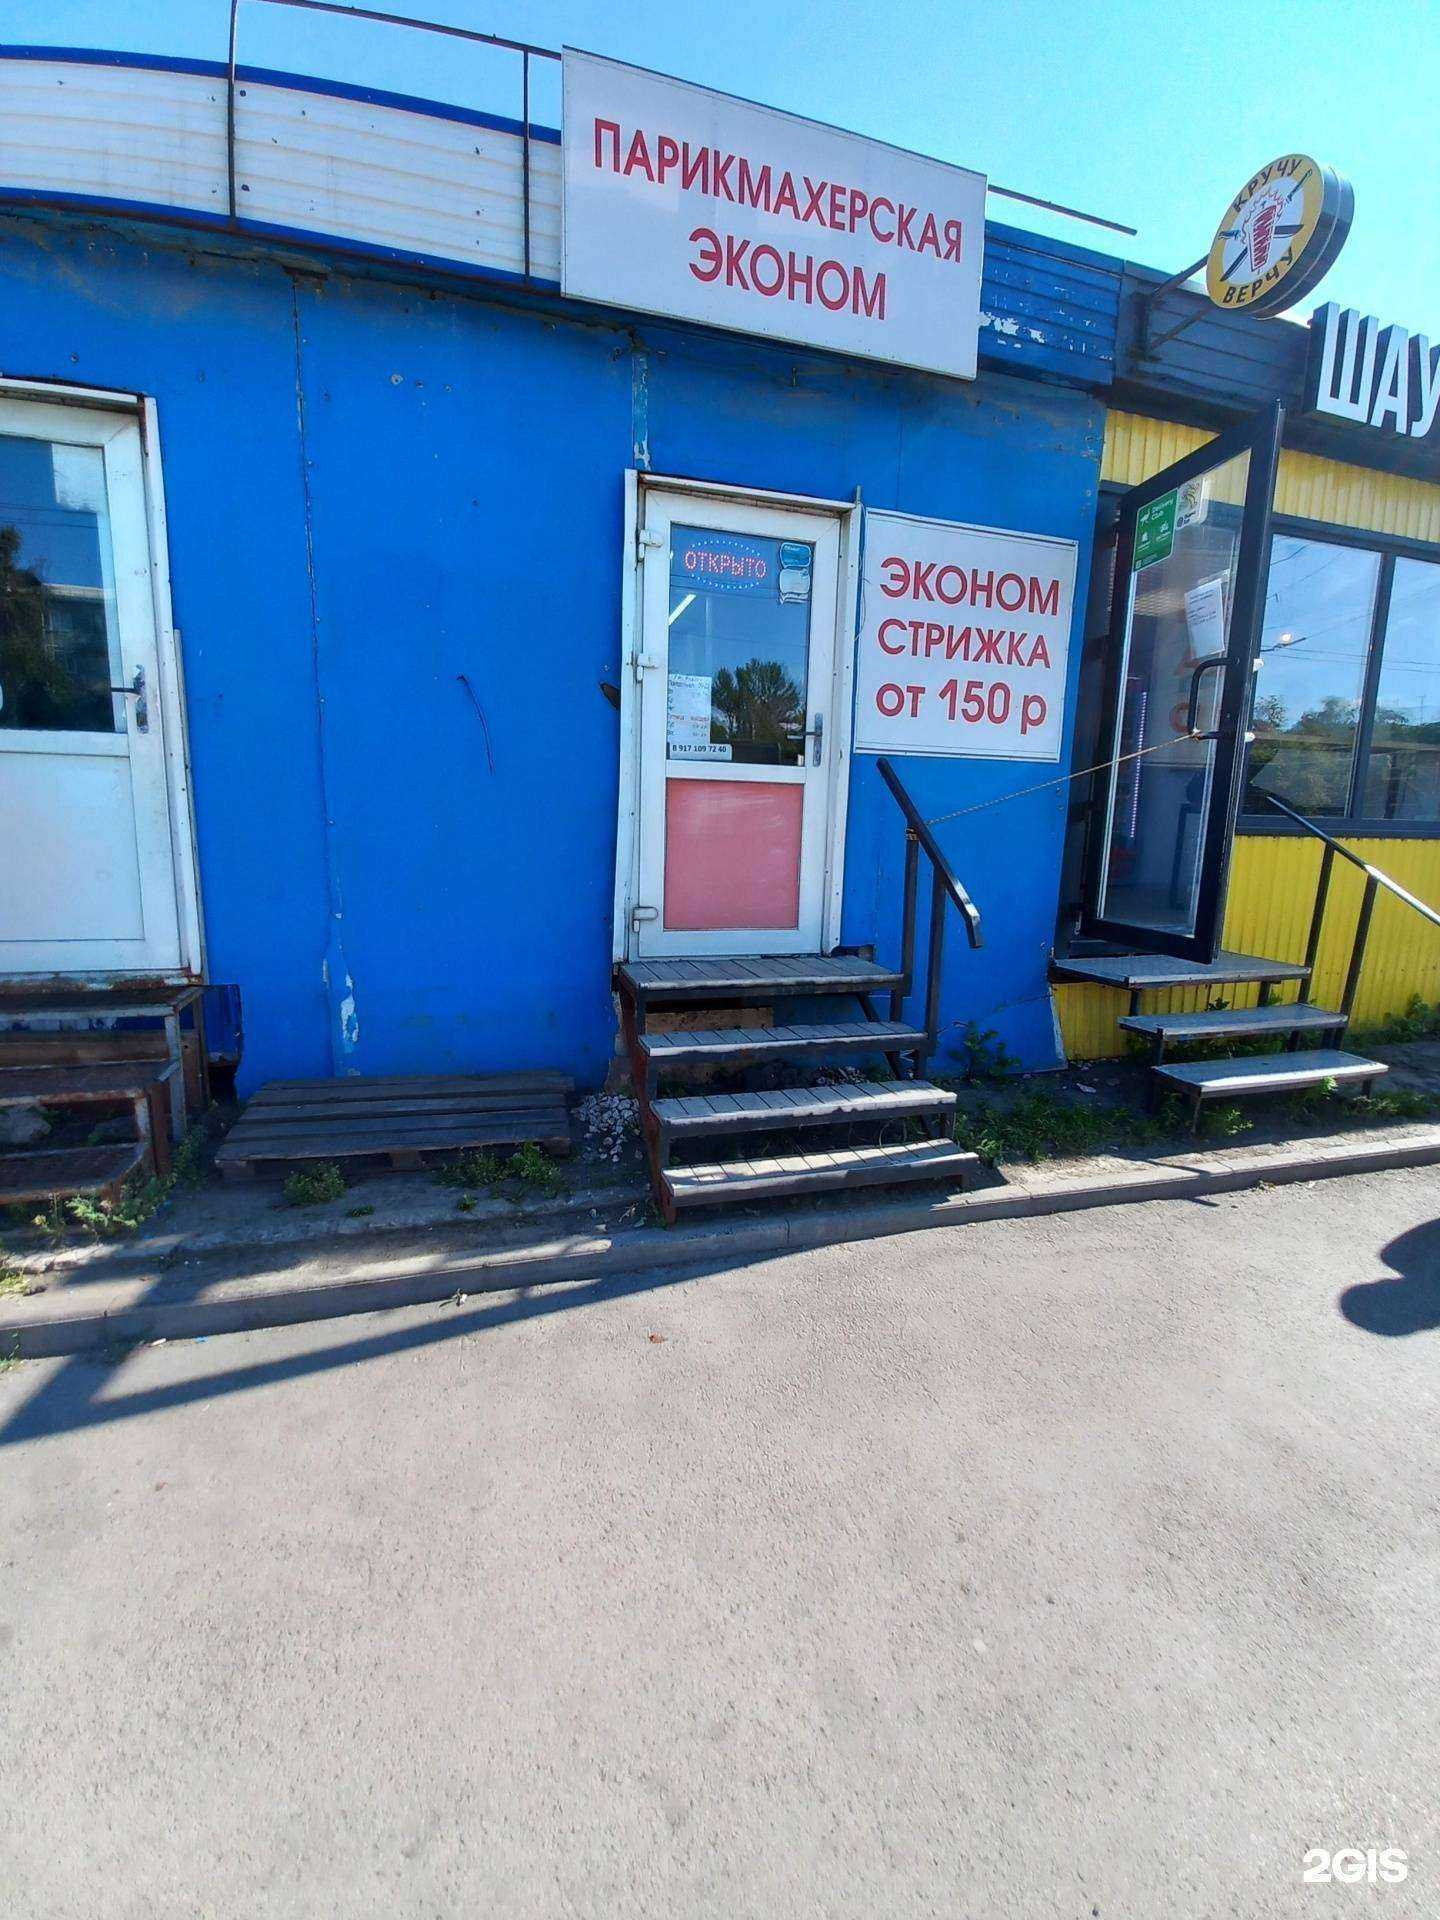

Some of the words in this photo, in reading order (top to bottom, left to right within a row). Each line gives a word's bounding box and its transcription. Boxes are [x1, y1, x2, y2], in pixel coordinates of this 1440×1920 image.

[594, 118, 962, 264] ПАРИКМАХЕРСКАЯ
[1233, 158, 1302, 213] КРУЧУ
[688, 227, 887, 320] ЭКОНОМ
[1222, 246, 1294, 304] ВЕРЧУ
[685, 551, 766, 578] ОТКРЫТО
[879, 557, 1060, 616] ЭКОНОМ
[877, 618, 1051, 669] СТРИЖКА
[938, 678, 1011, 725] 150
[1020, 694, 1047, 735] р
[678, 744, 692, 752] 917
[693, 745, 707, 753] 109
[708, 745, 717, 753] 72
[717, 745, 727, 753] 40
